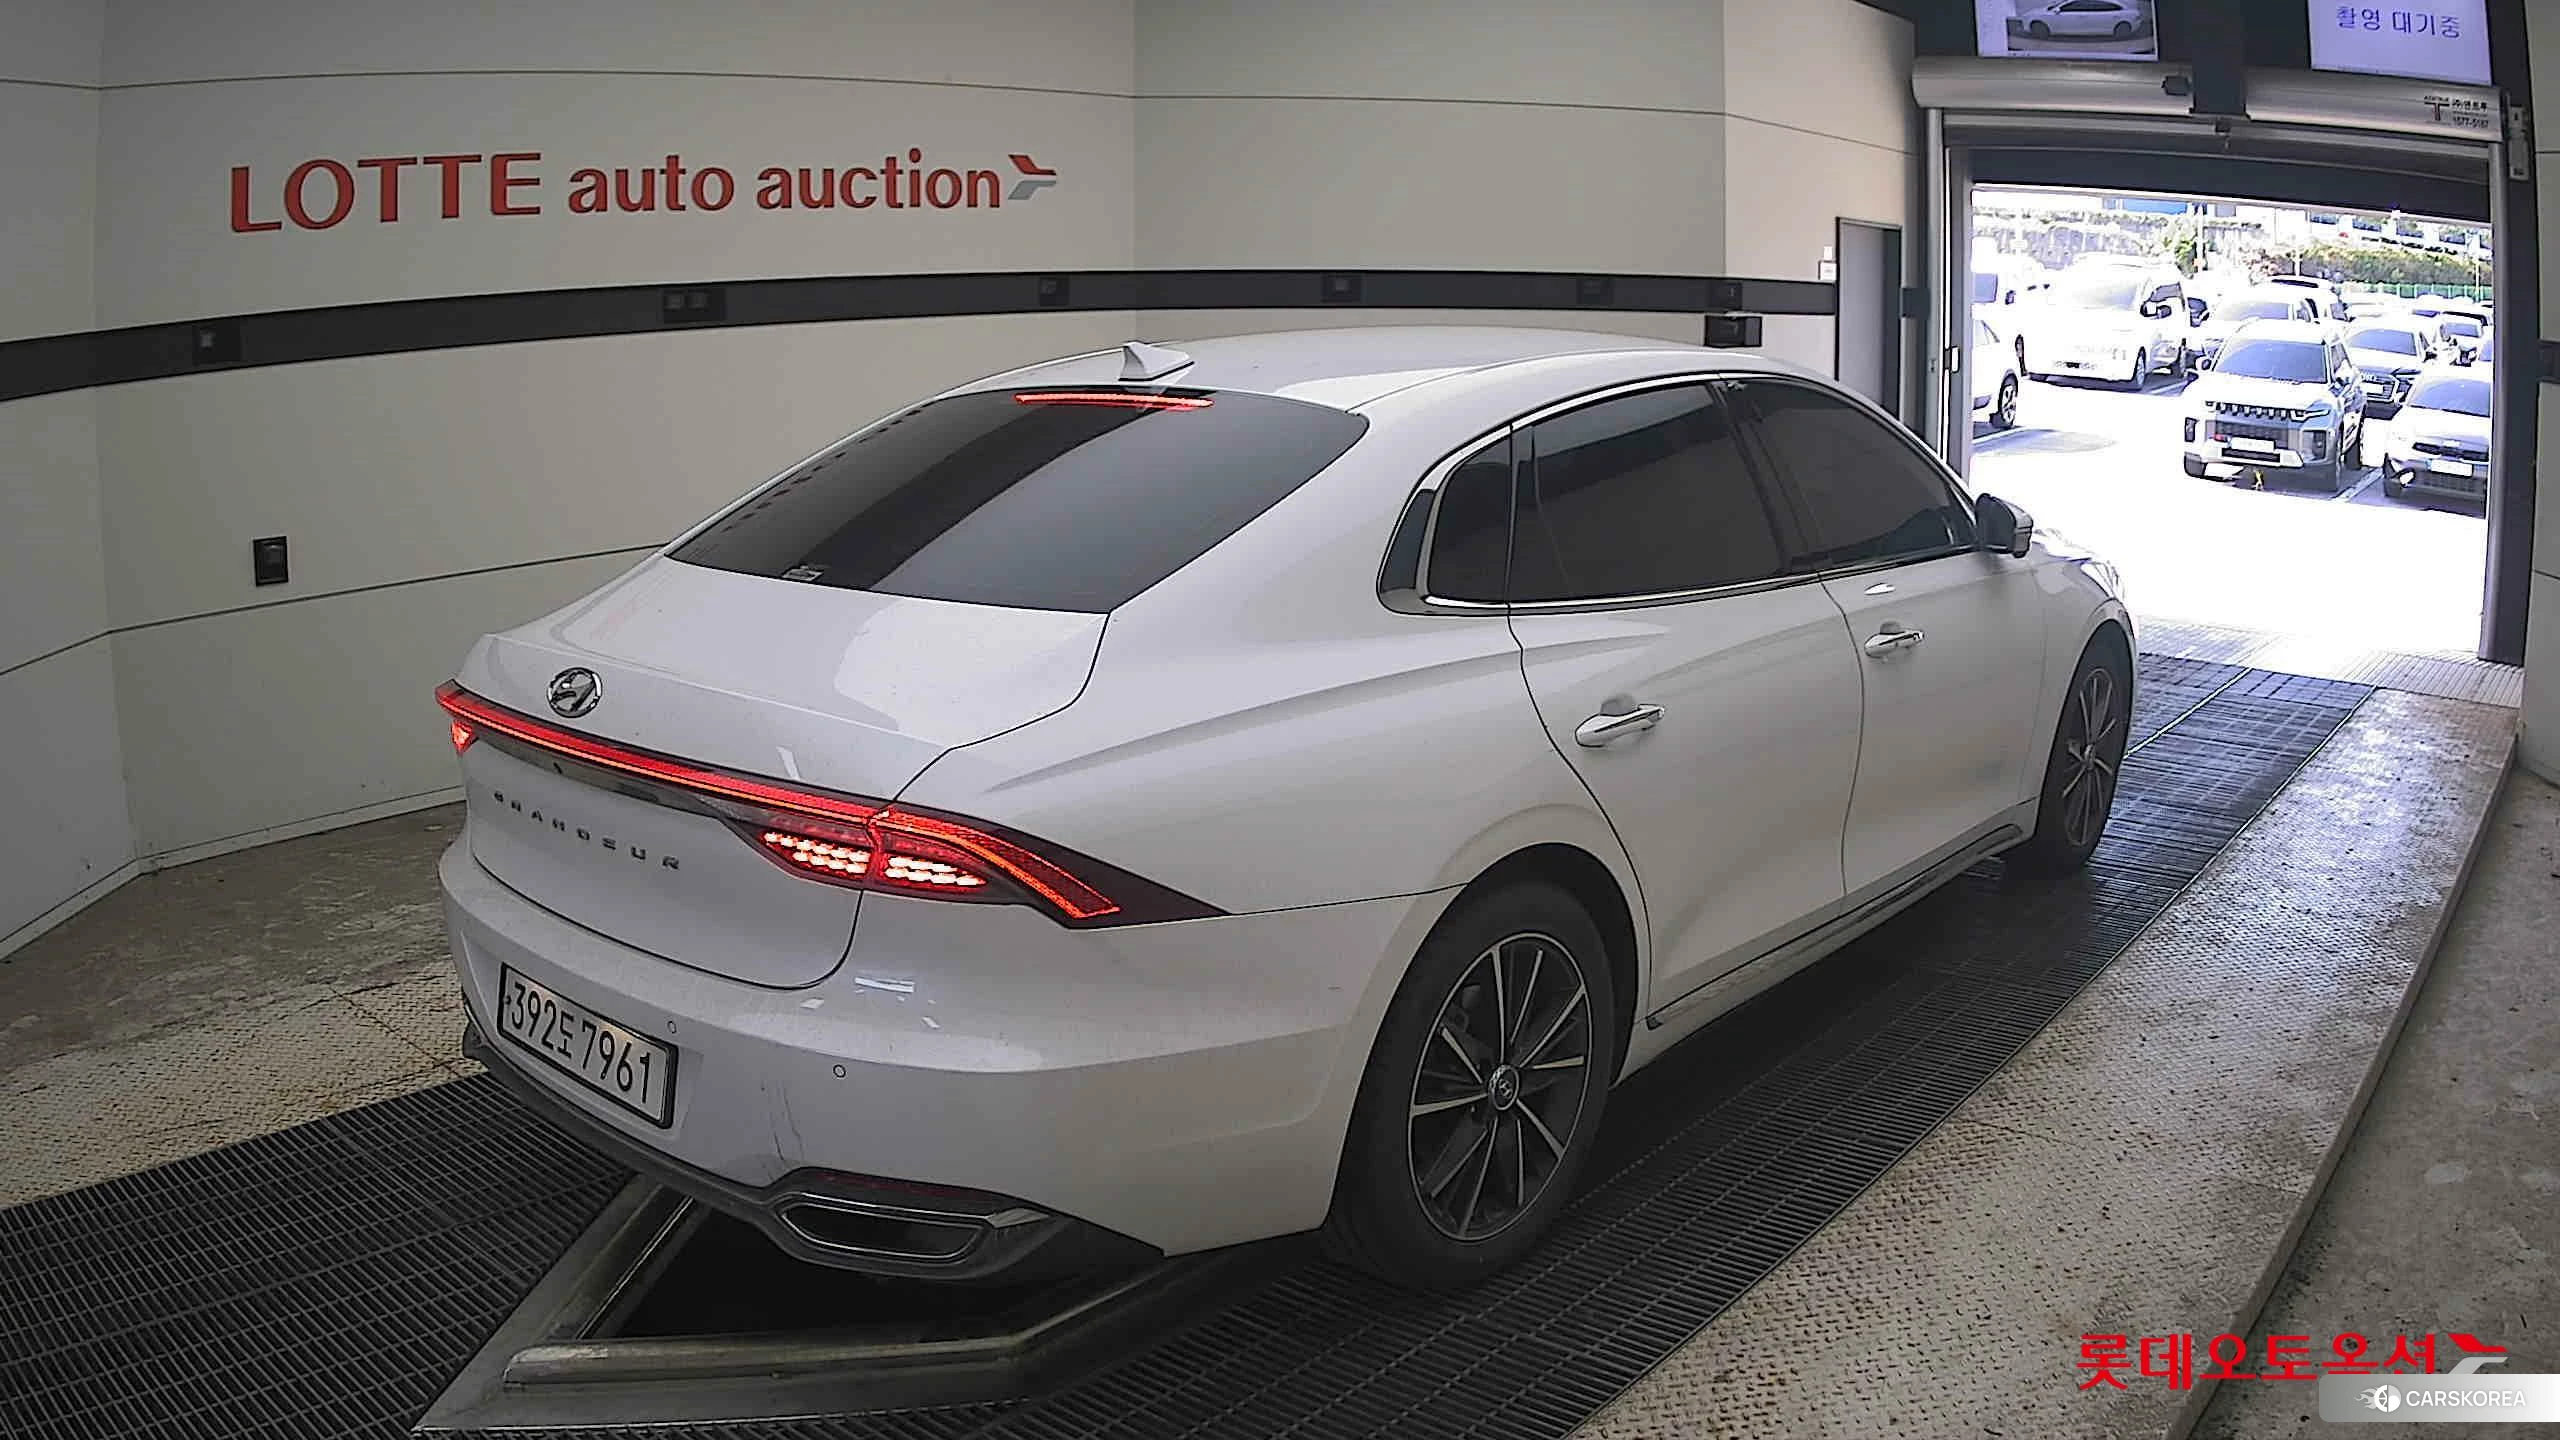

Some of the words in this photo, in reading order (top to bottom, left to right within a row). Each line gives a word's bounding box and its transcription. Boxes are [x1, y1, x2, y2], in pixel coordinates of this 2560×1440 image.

[2337, 6, 2381, 32] 촬영
[2392, 11, 2460, 39] 대기중
[231, 153, 540, 233] LOTTE
[568, 155, 735, 213] auto
[756, 148, 1001, 210] auction
[511, 981, 653, 1104] 392도7961
